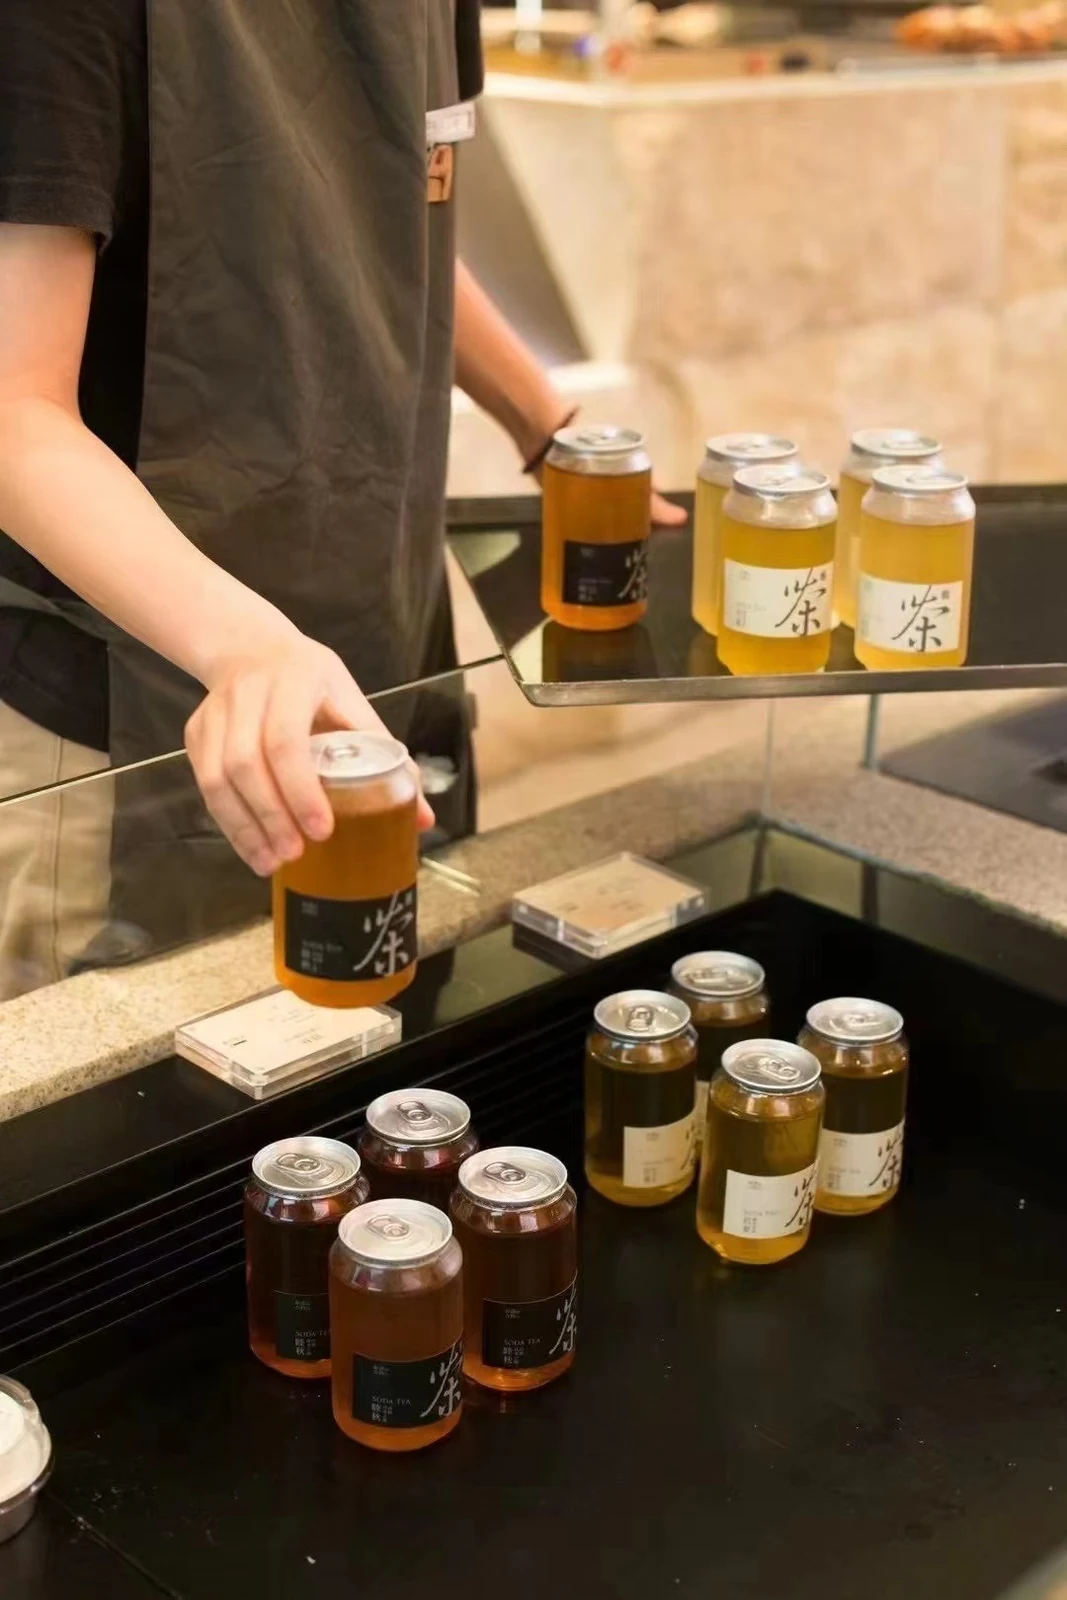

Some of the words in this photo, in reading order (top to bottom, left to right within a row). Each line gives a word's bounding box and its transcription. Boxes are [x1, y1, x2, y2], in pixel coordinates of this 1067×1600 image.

[504, 1338, 525, 1346] SODA
[527, 1337, 541, 1345] TEA
[372, 1395, 393, 1405] SODA
[397, 1397, 411, 1406] TEA
